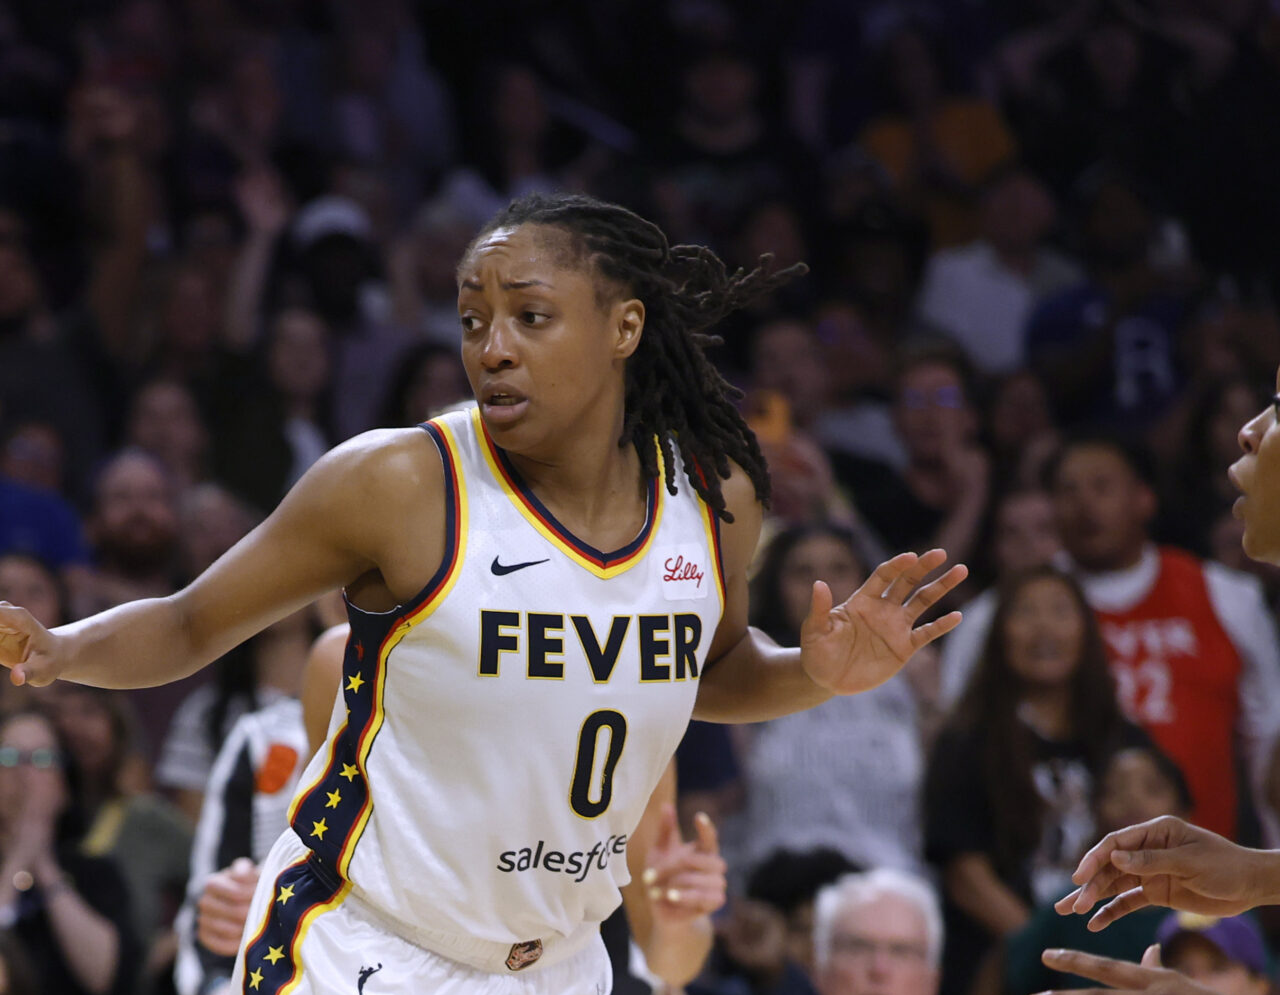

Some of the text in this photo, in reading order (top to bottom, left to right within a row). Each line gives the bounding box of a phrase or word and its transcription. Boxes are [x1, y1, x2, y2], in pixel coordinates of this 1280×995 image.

[663, 555, 705, 588] Lilly
[477, 608, 703, 684] FEVER
[568, 707, 629, 820] 0
